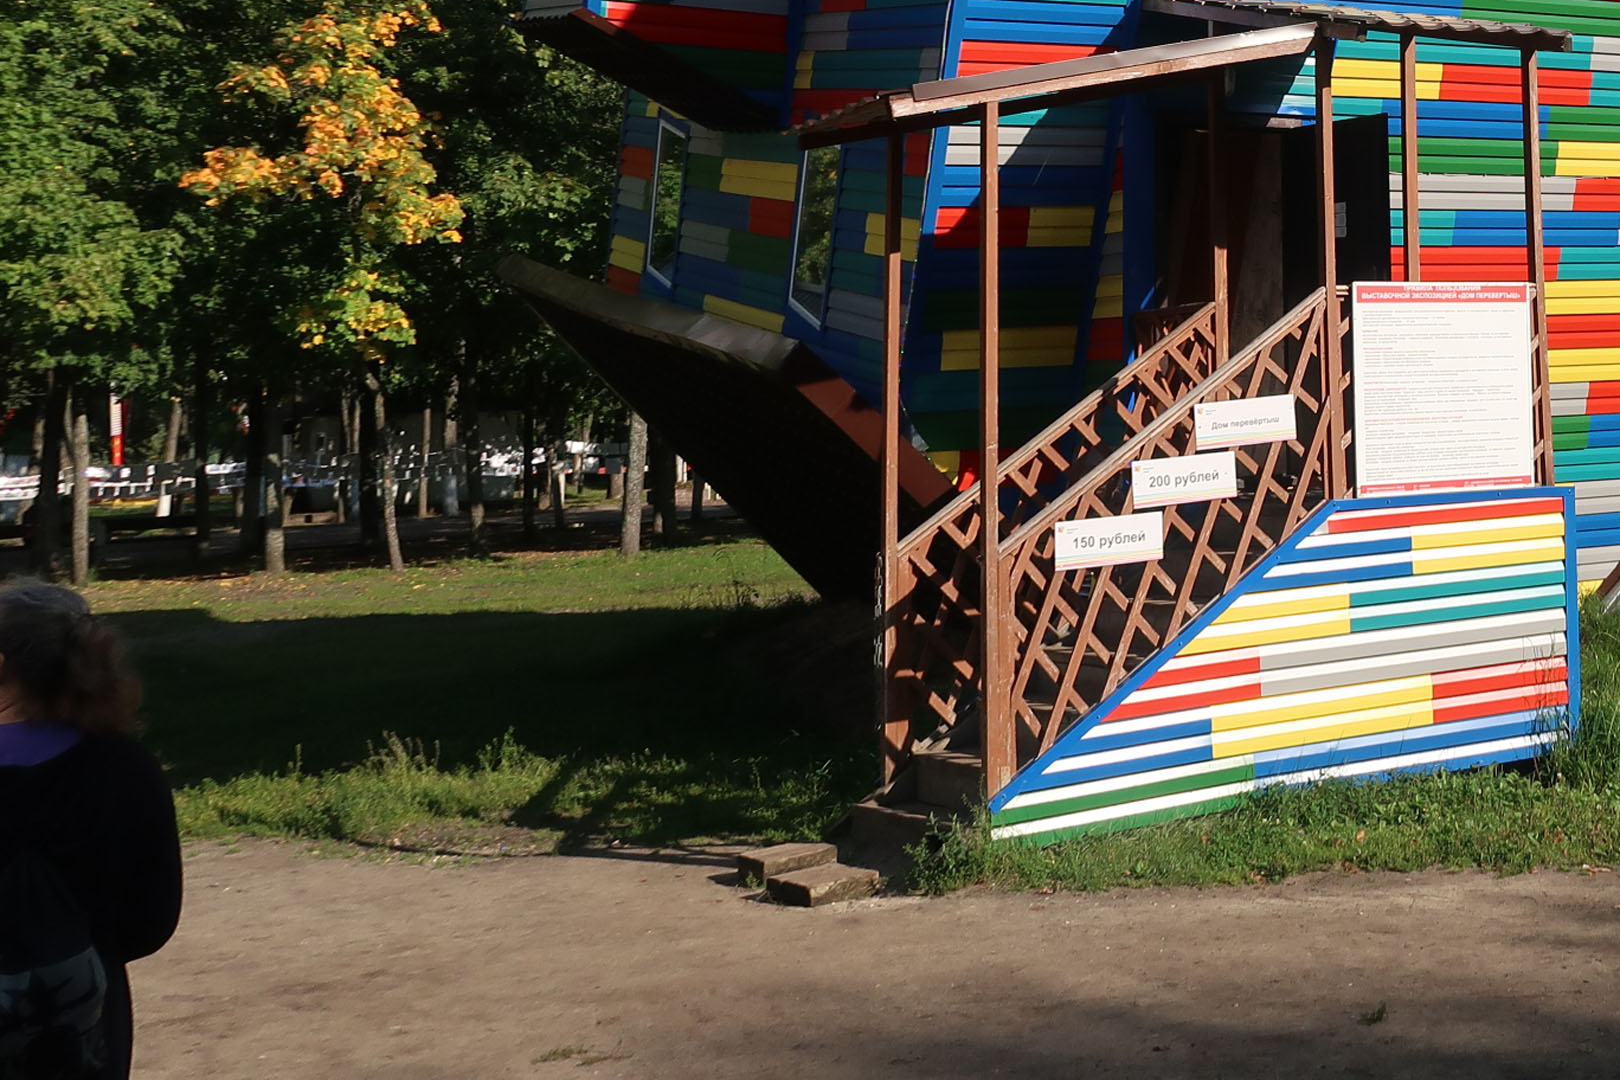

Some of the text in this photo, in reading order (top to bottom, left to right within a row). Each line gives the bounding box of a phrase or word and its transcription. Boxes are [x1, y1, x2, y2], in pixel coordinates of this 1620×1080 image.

[1361, 291, 1411, 299] ВЫСТАВОЧНОЙ
[1412, 291, 1457, 300] ЭКСПОЗИЦИЕЙ
[1211, 417, 1280, 431] Дом перевёртыш
[1149, 469, 1220, 488] 200 рублей
[1072, 530, 1146, 549] 150 рублей
